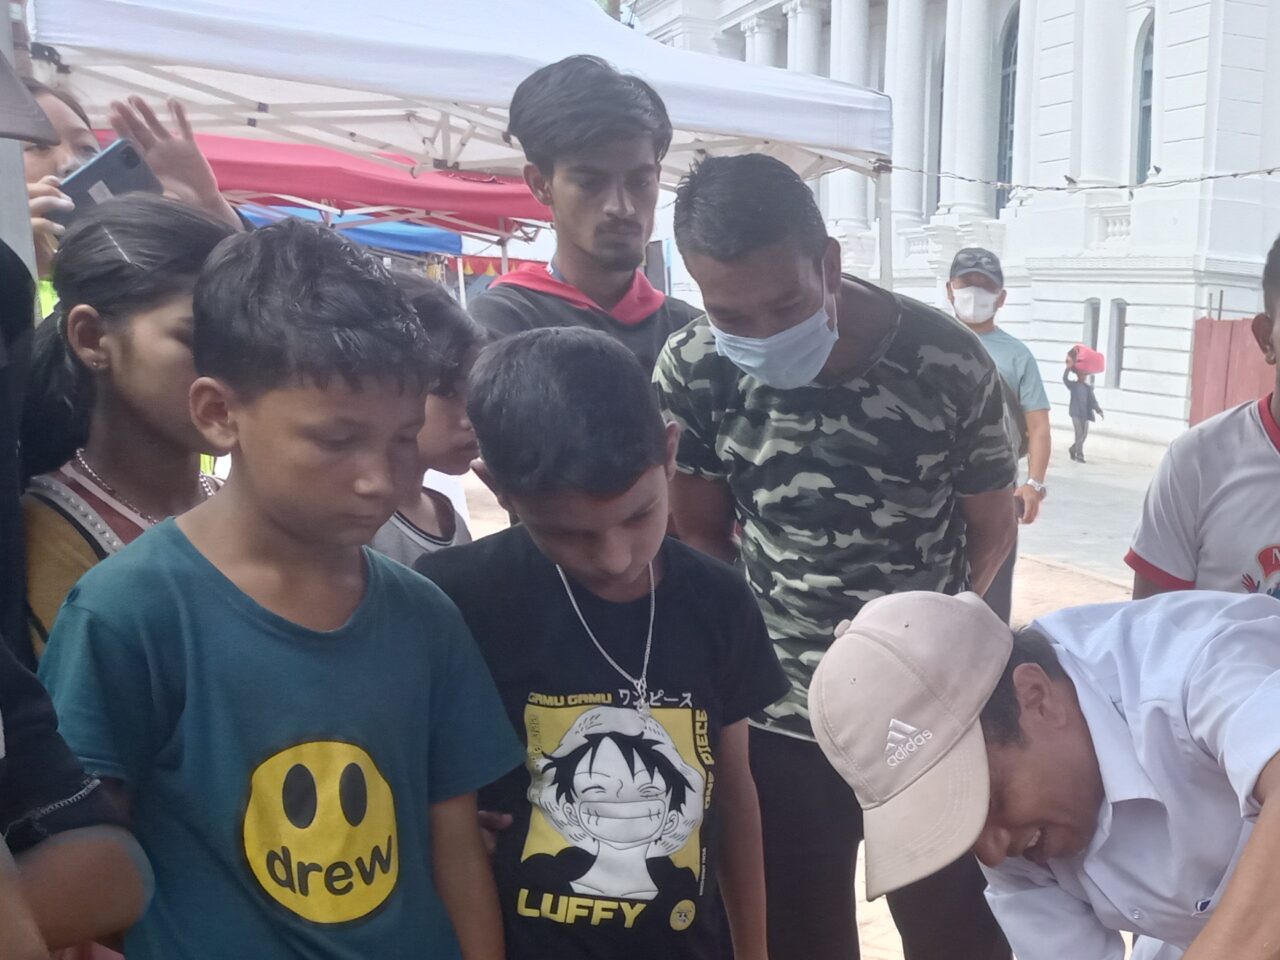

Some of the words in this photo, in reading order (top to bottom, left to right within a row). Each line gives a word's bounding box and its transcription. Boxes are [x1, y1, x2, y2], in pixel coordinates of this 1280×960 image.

[694, 709, 715, 767] PIECE
[886, 727, 934, 768] adidas
[266, 834, 393, 896] drew
[516, 888, 647, 929] LUFFY
